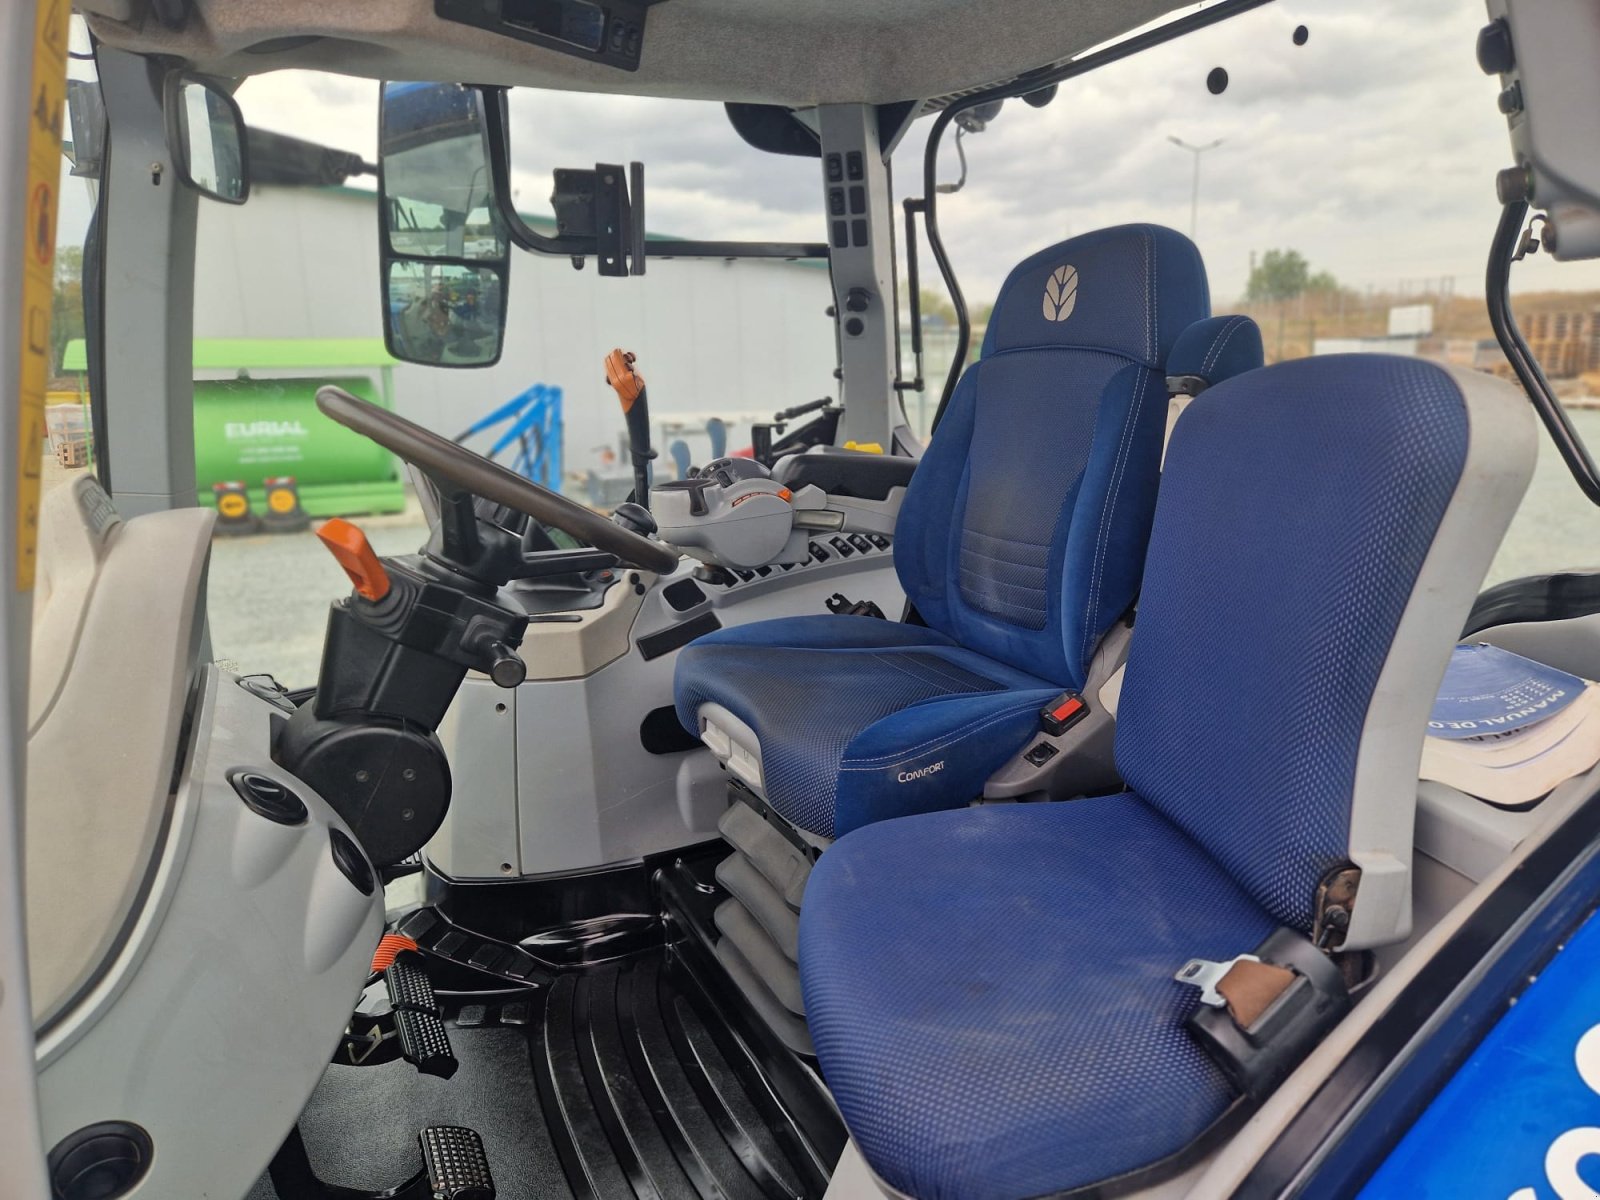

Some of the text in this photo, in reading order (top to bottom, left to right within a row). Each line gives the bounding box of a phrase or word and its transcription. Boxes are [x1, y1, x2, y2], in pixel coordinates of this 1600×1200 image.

[1479, 690, 1566, 726] MANUAL
[1451, 721, 1478, 729] DE
[897, 760, 945, 783] COMFORT
